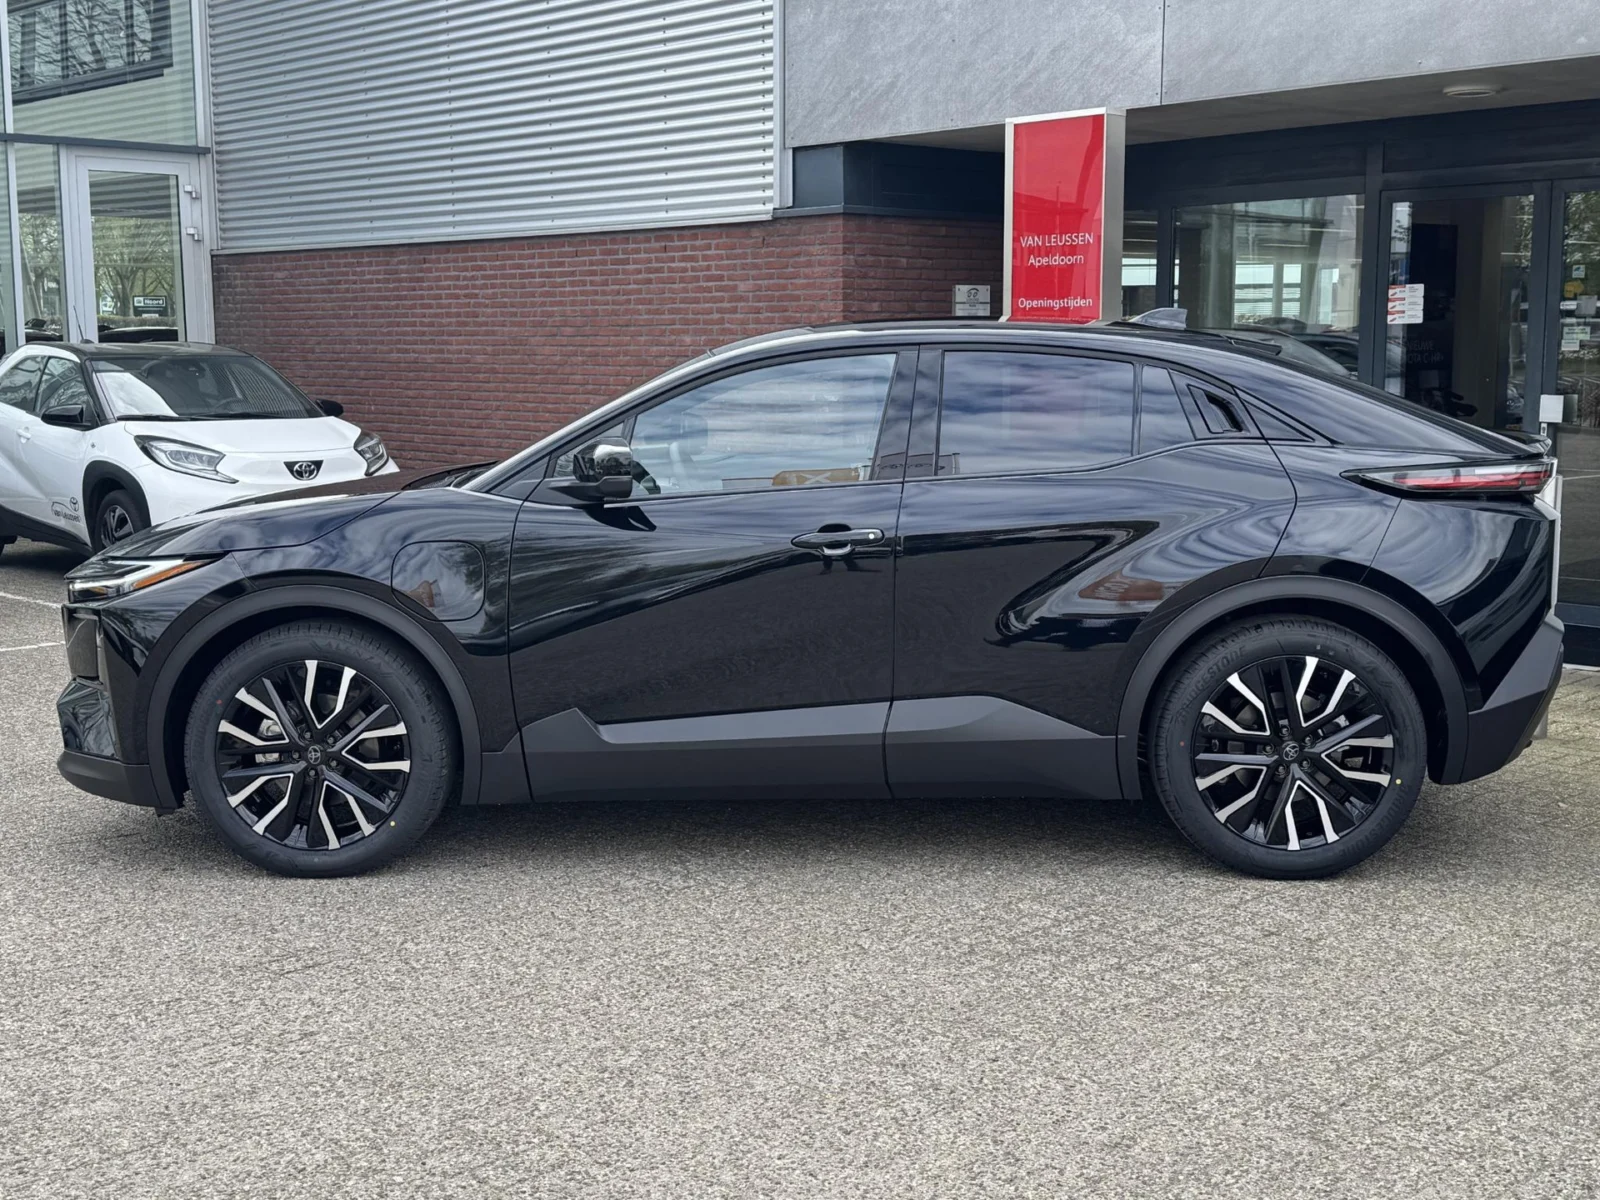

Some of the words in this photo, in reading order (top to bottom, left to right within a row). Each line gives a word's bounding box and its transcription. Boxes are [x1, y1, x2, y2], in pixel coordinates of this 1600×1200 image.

[1020, 235, 1042, 248] VAN
[1045, 232, 1094, 246] LEUSSEN
[1028, 253, 1084, 268] Apeldoorn
[1018, 296, 1093, 311] Openingstijden
